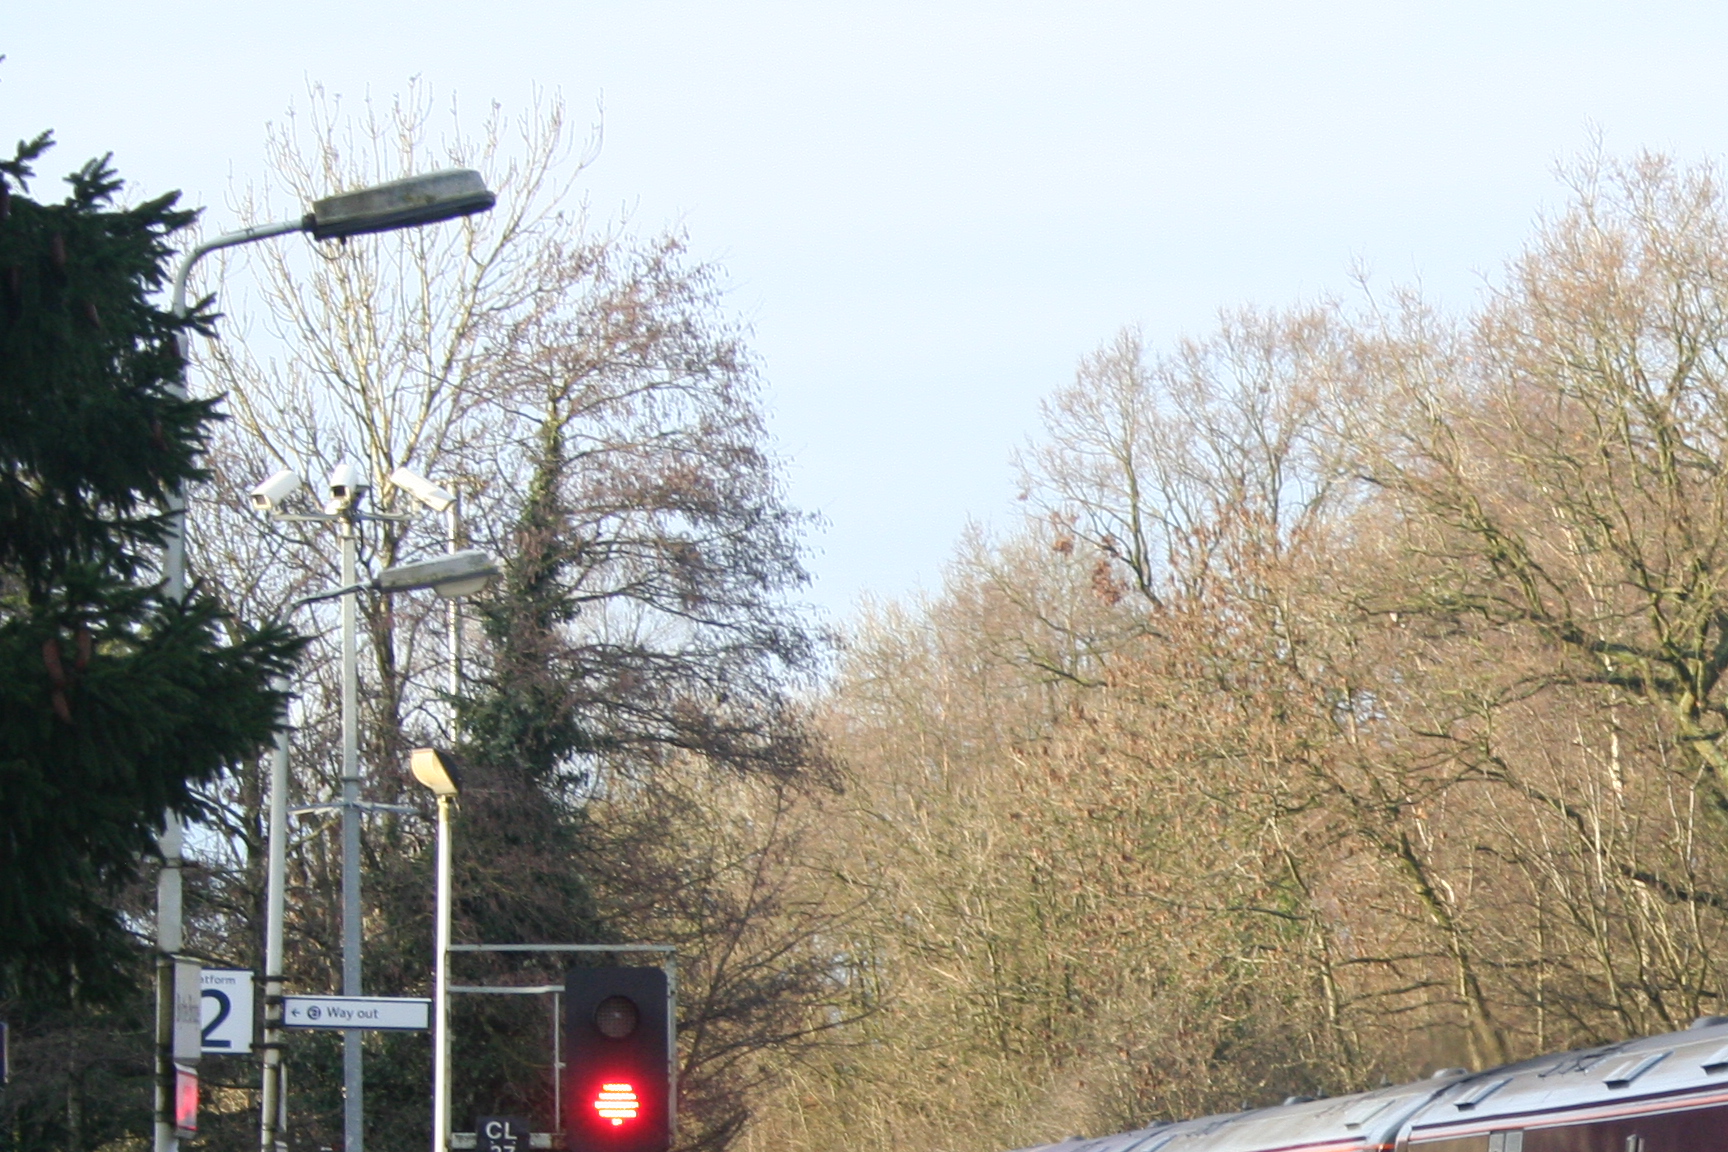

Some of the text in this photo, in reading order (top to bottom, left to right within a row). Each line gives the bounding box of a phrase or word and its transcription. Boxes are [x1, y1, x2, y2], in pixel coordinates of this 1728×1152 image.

[201, 988, 232, 1048] 2
[327, 1006, 379, 1020] Way out
[486, 1121, 518, 1140] CL
